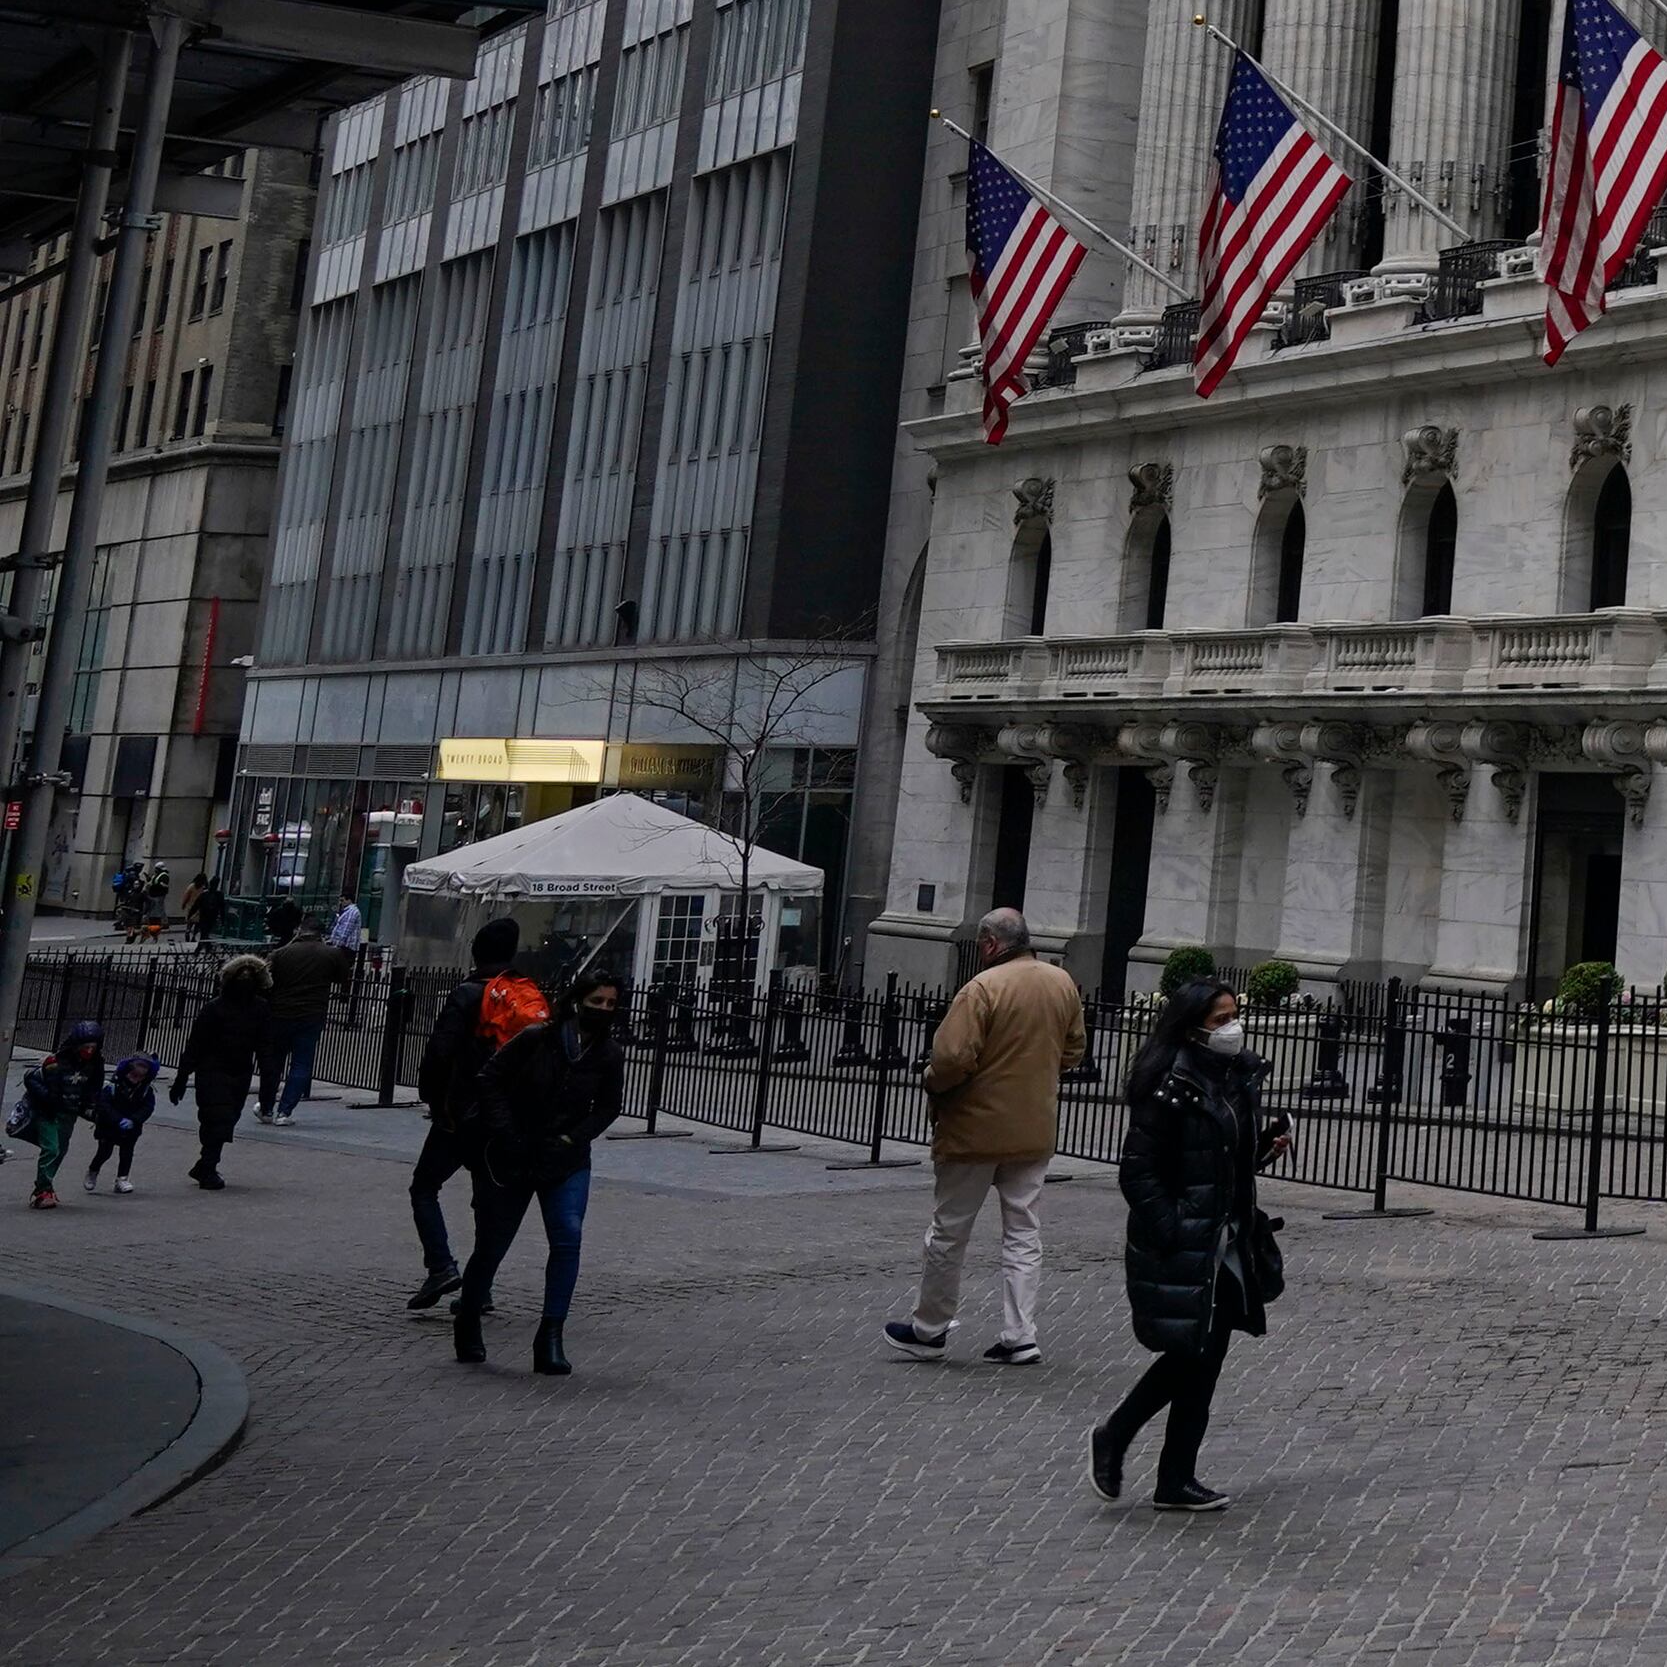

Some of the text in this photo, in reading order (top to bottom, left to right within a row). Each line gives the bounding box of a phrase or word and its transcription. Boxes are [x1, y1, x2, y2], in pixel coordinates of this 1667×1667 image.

[446, 754, 503, 765] TWENTY BROAD
[532, 883, 616, 892] 18 Broad Street
